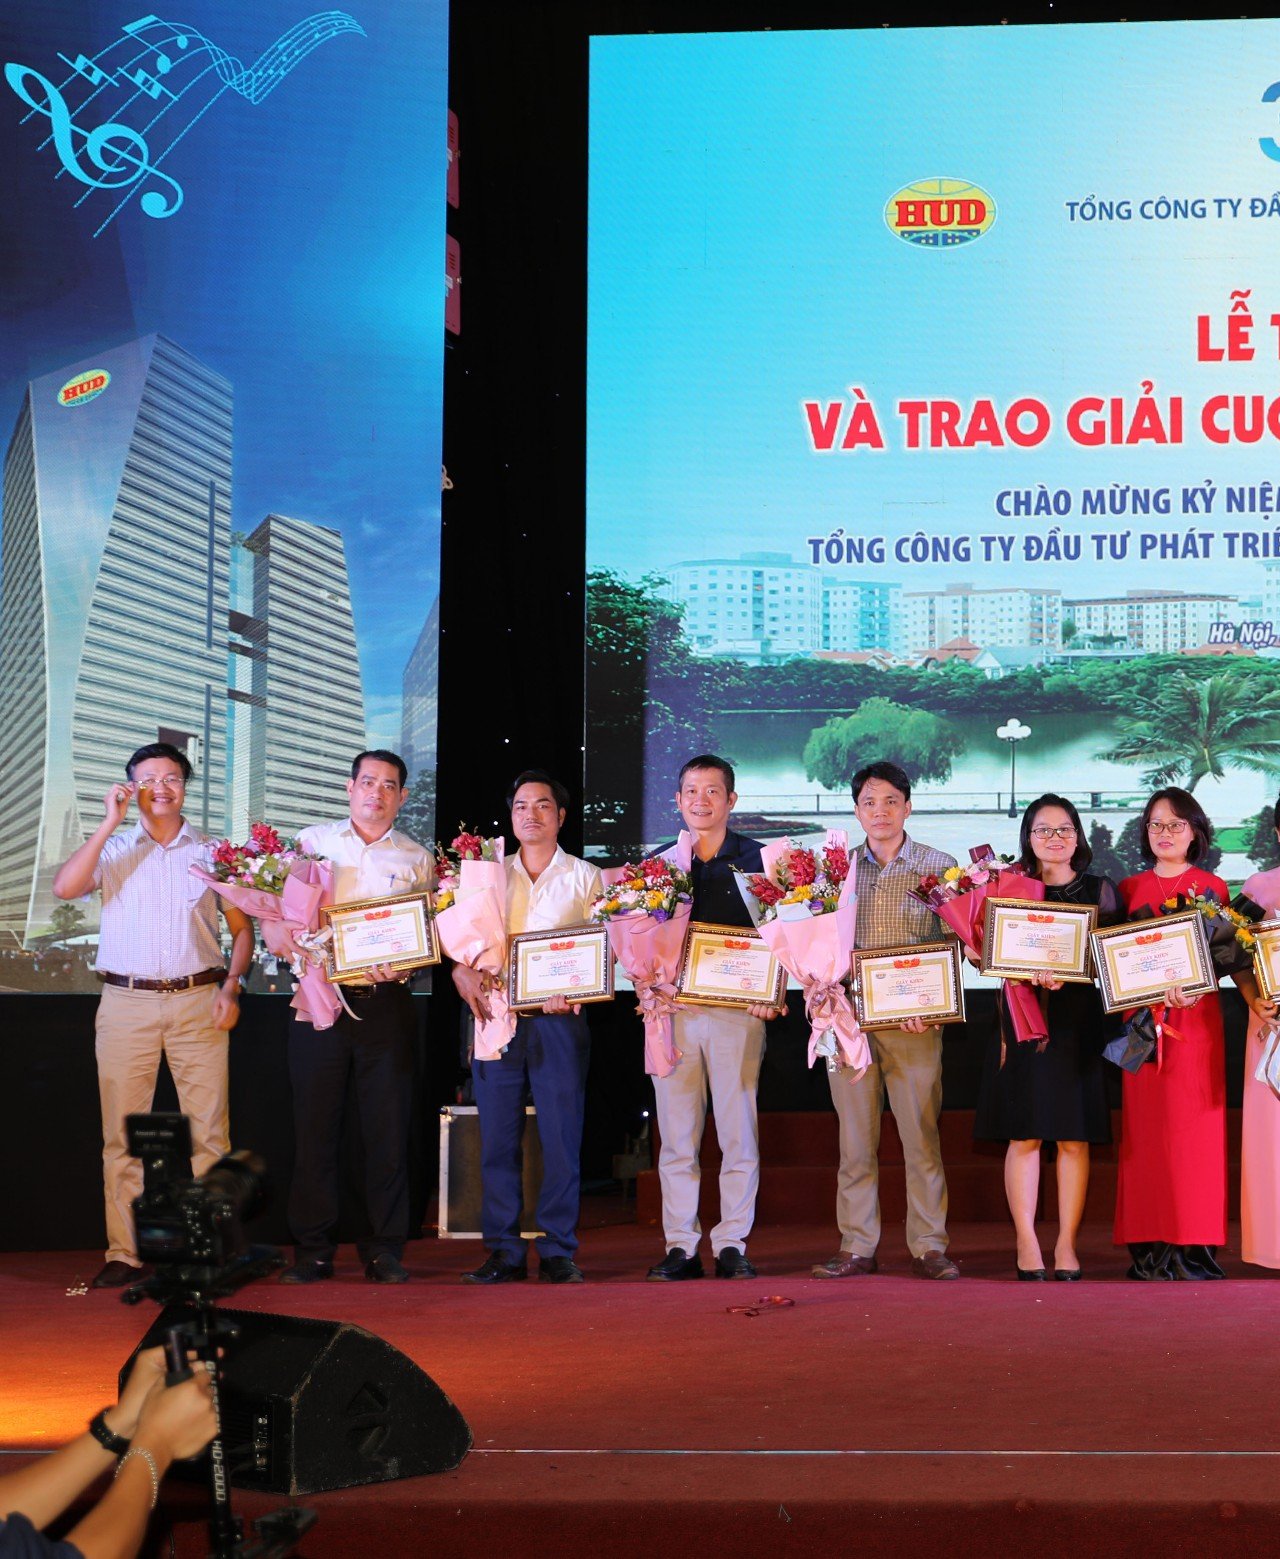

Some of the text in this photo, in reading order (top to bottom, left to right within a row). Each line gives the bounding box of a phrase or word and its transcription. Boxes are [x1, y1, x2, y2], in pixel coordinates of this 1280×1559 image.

[895, 199, 987, 227] HUD
[1066, 194, 1132, 221] TỔNG
[1139, 196, 1207, 220] CÔNG
[1213, 198, 1242, 218] TY
[1198, 290, 1255, 361] LỄ
[63, 375, 106, 402] HUD
[805, 388, 884, 449] VÀ
[899, 399, 1051, 448] TRAO
[1066, 380, 1183, 445] GIẢI
[996, 486, 1072, 516] CHÀO
[1081, 483, 1171, 515] MỪNG
[1182, 480, 1217, 513] KỶ
[808, 528, 885, 564] TỔNG
[895, 531, 971, 563] CÔNG
[980, 536, 1015, 562] TY
[1023, 527, 1081, 561] ĐẦU
[1091, 530, 1131, 560] TƯ
[1140, 527, 1215, 559] PHÁT
[1208, 622, 1235, 644] Hà
[1239, 621, 1277, 649] Nội,
